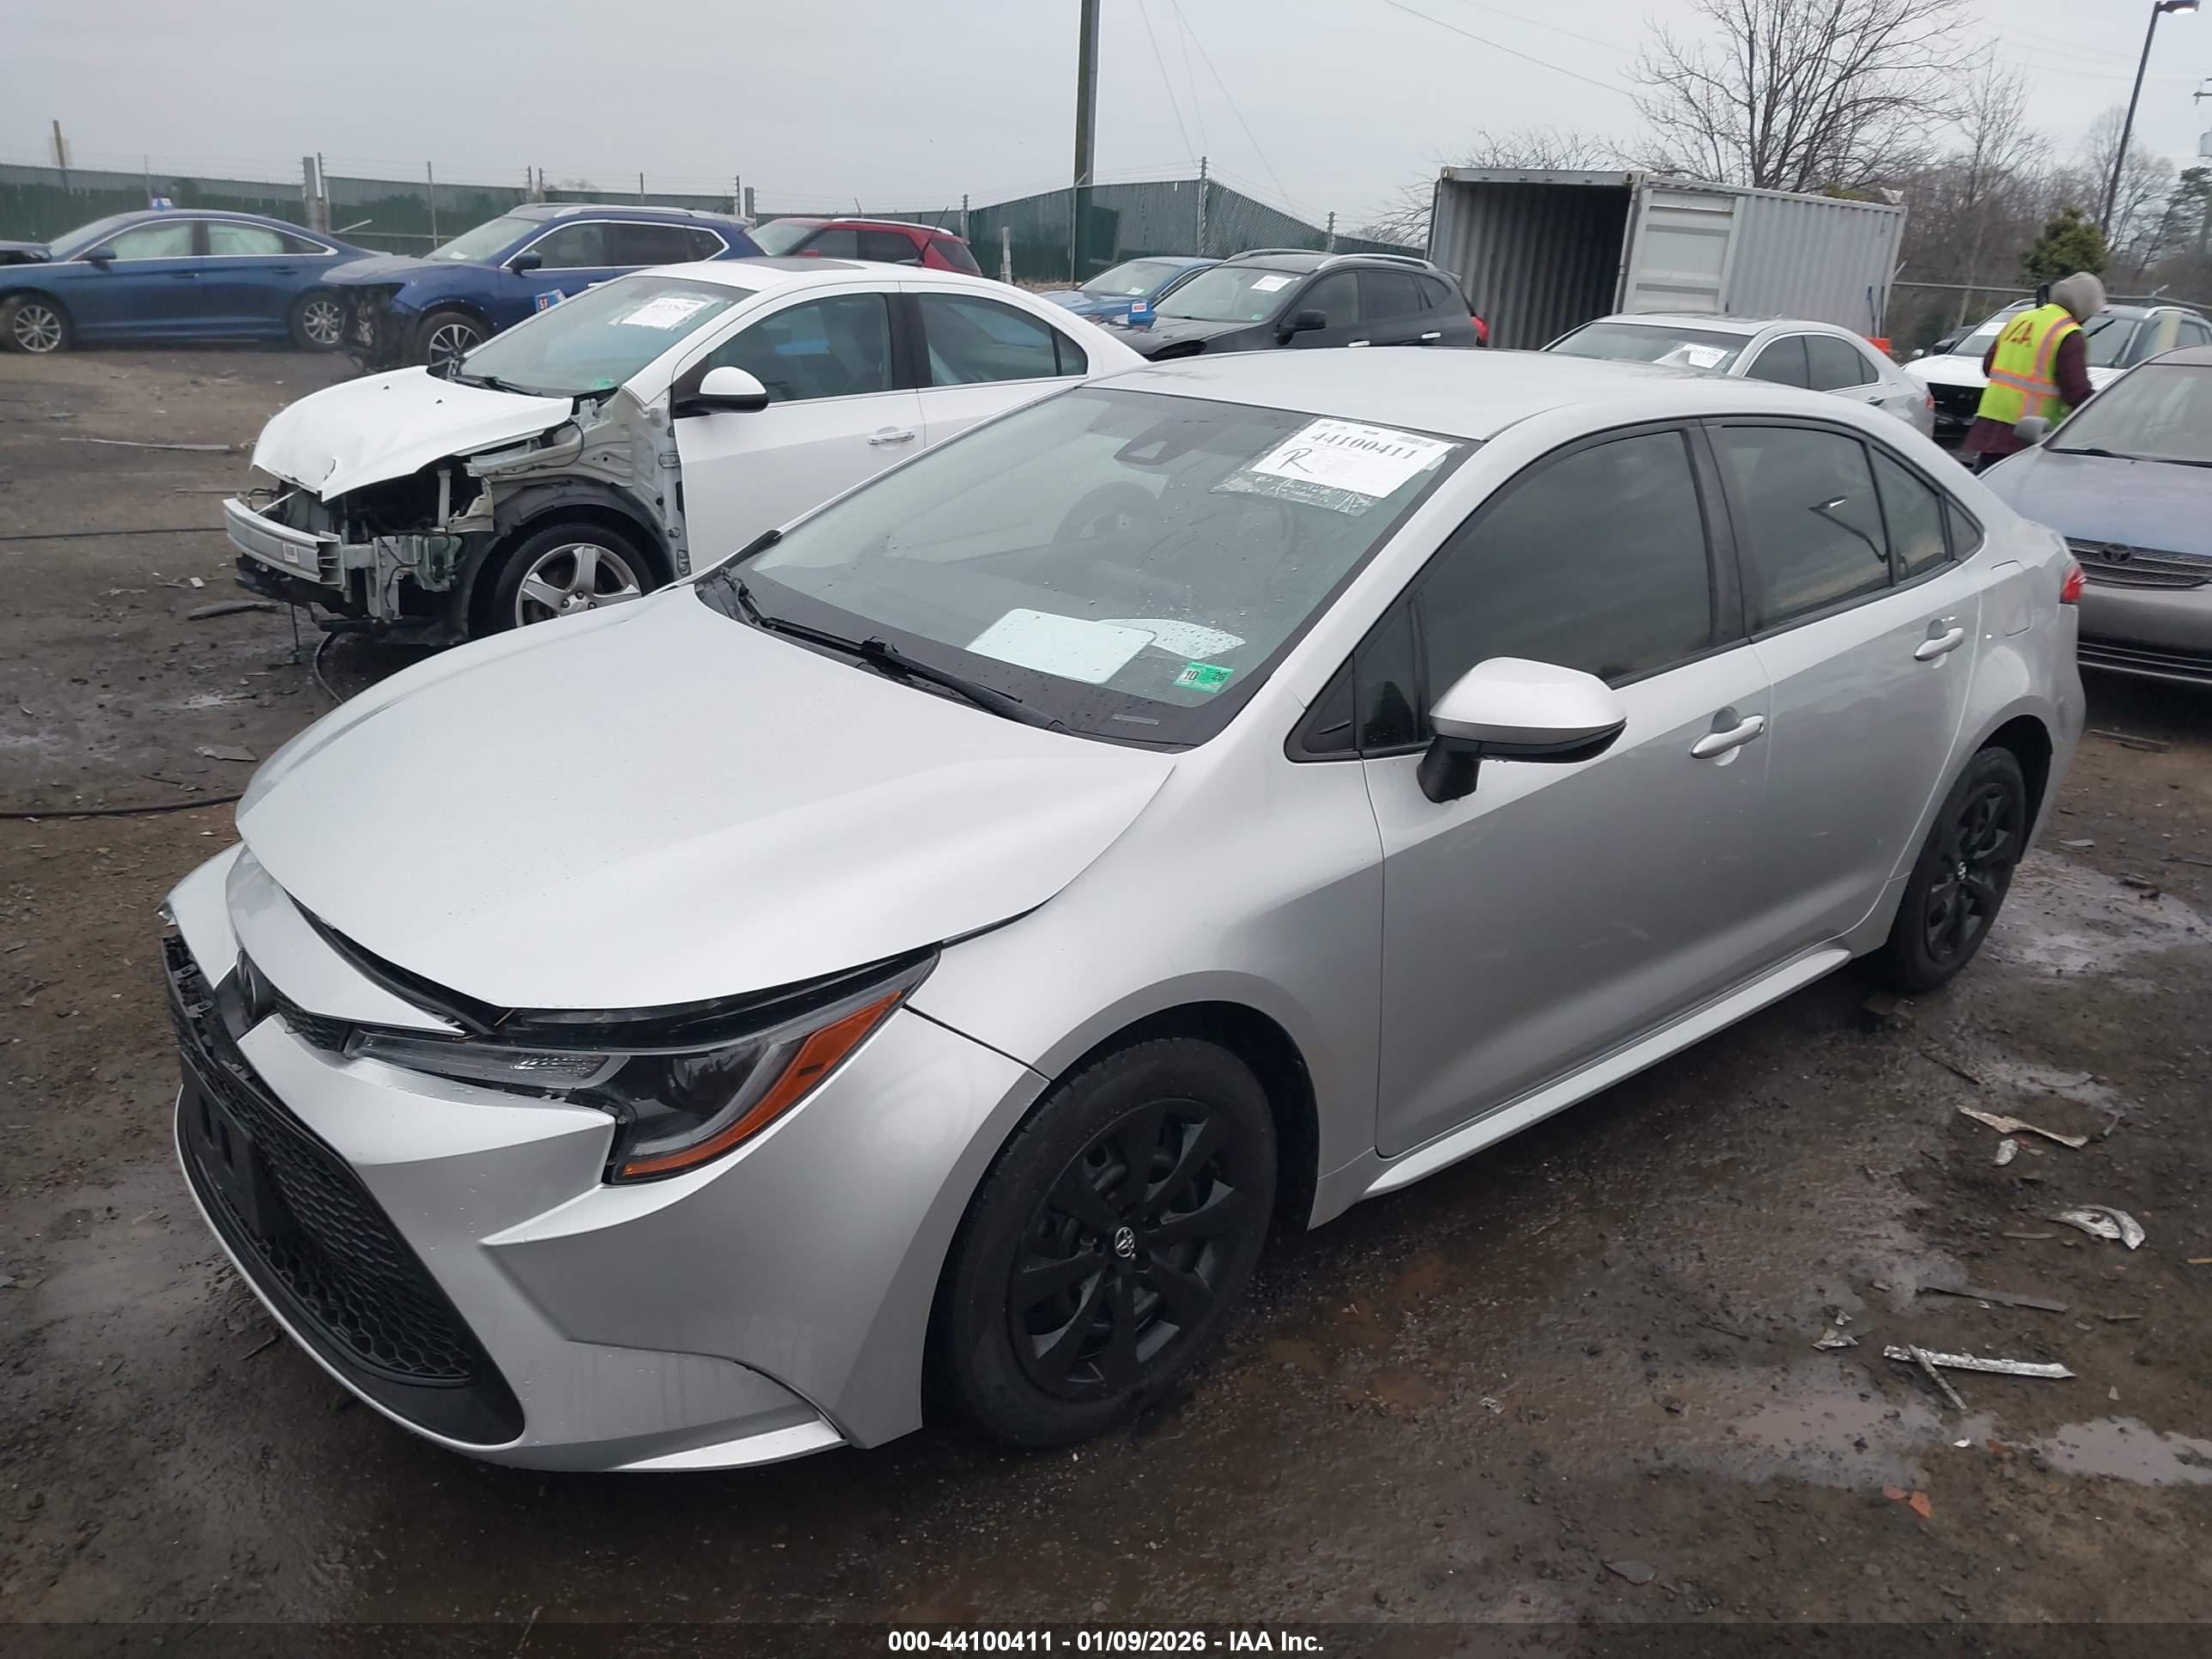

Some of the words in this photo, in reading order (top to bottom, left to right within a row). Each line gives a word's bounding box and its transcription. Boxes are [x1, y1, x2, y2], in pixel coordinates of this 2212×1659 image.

[1310, 432, 1418, 459] 44100411
[1278, 447, 1312, 474] R
[1183, 670, 1200, 681] 10
[1212, 672, 1227, 682] 26
